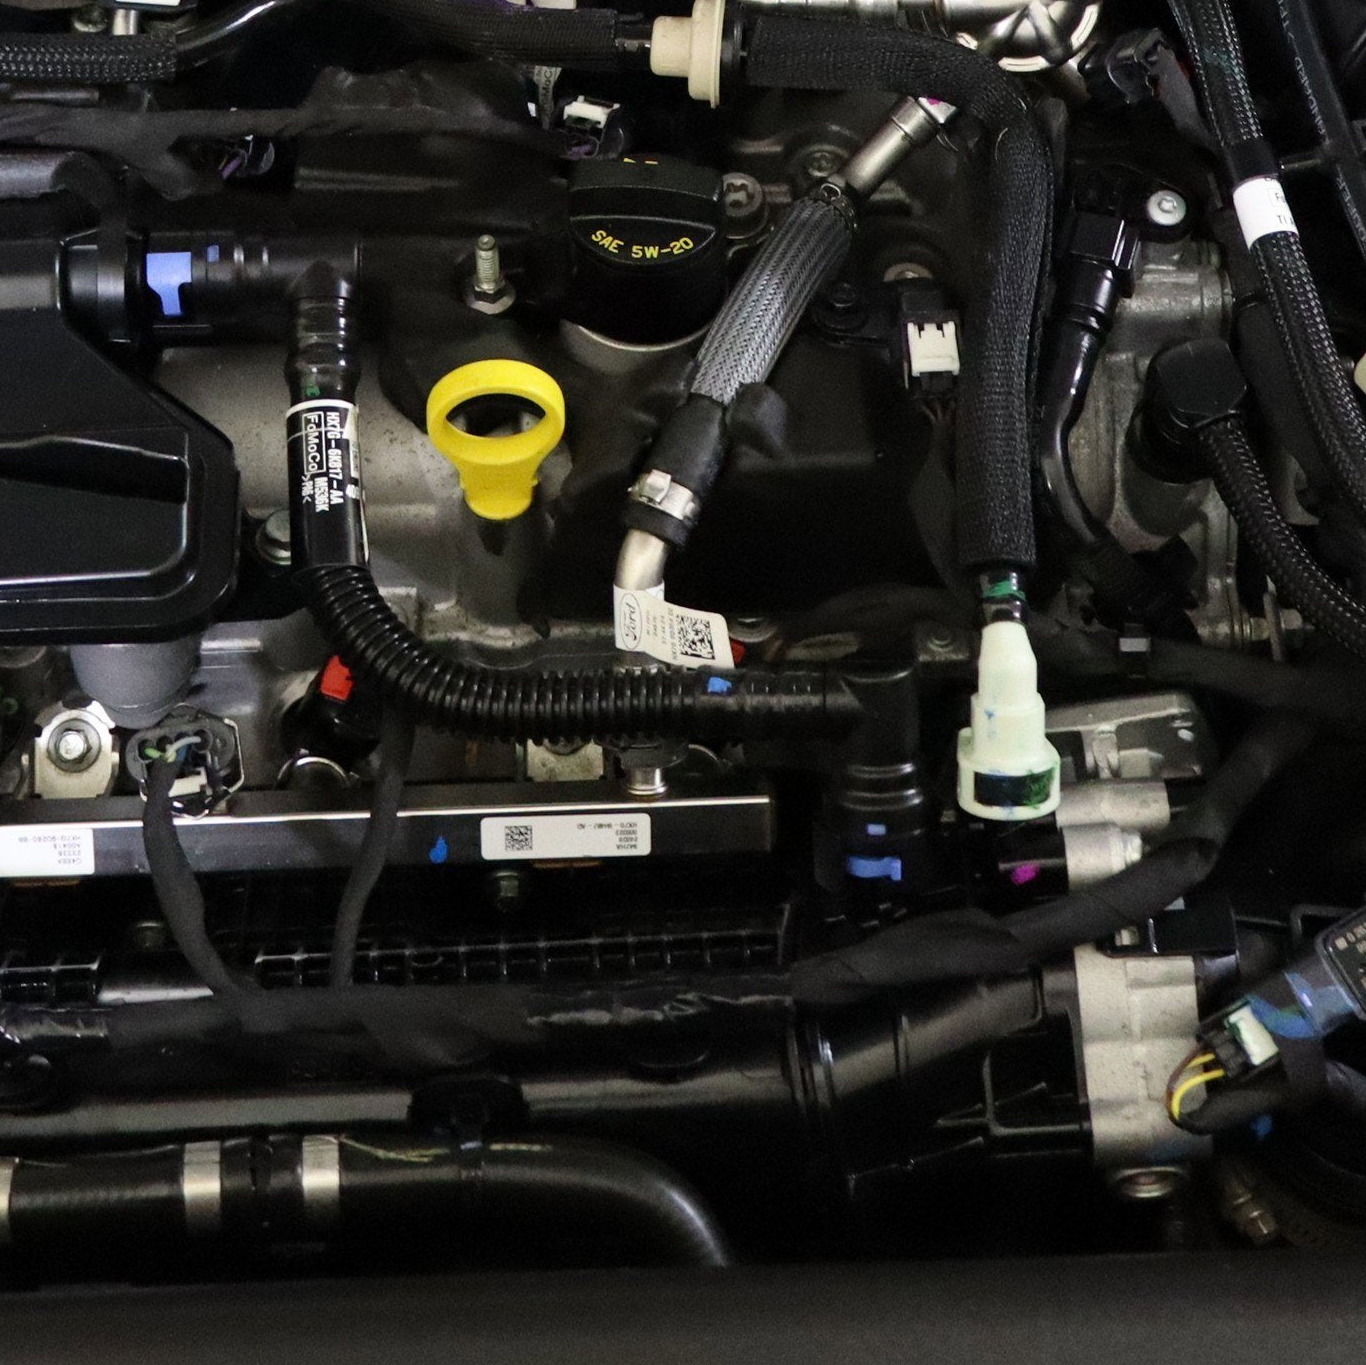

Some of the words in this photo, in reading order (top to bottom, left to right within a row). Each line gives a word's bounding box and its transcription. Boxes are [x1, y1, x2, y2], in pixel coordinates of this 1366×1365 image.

[591, 229, 624, 253] SAE
[631, 236, 694, 259] 5W-20
[306, 415, 320, 472] FoMoCo
